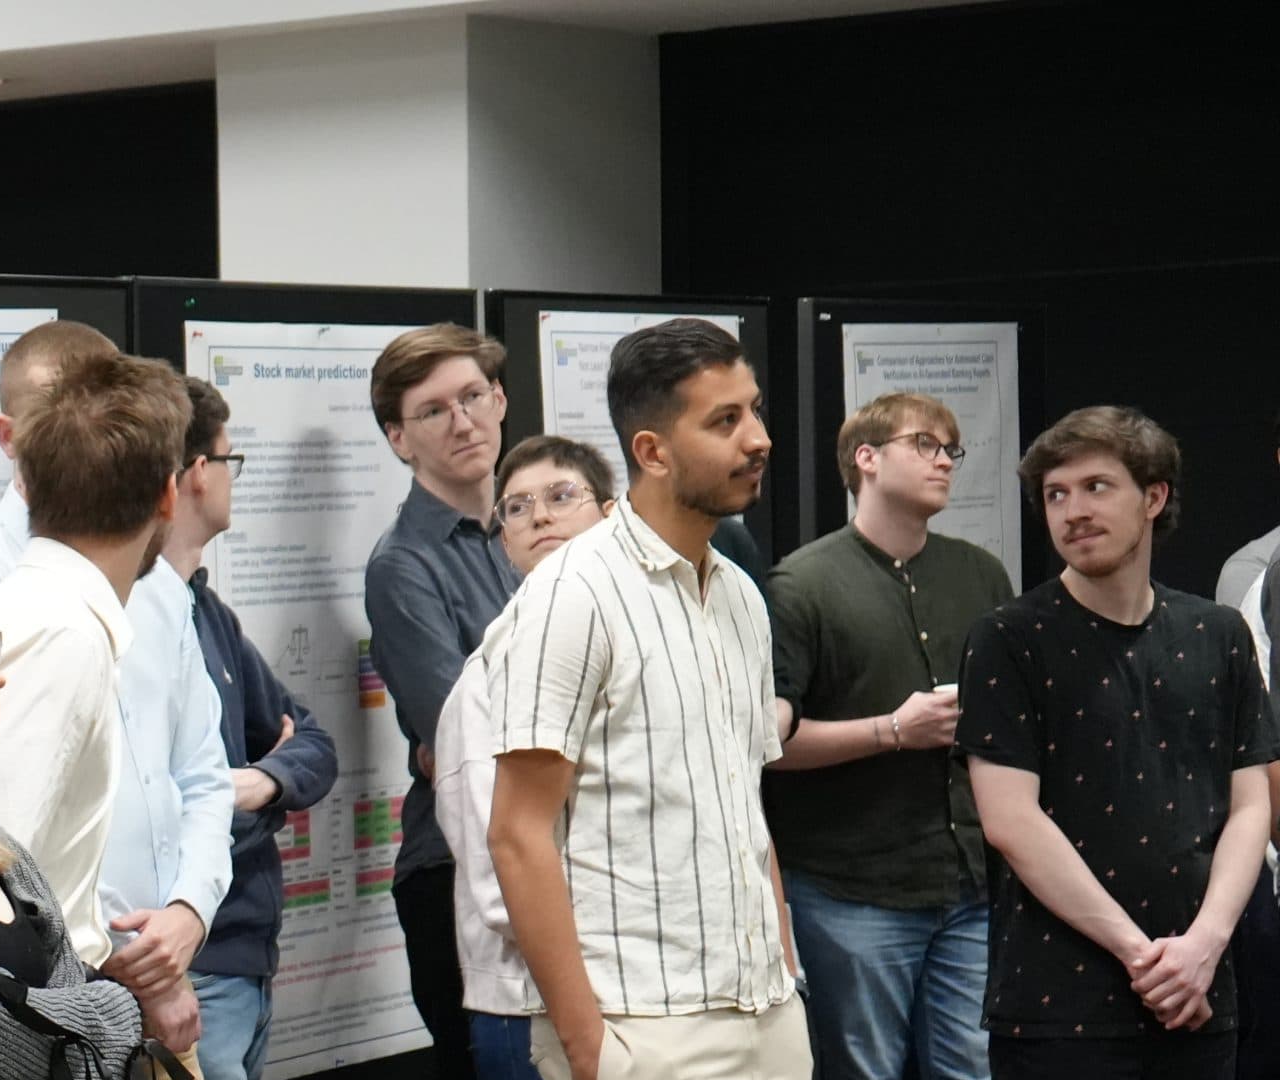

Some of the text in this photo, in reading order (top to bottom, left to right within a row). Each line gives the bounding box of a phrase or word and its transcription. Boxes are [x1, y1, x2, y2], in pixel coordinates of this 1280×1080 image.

[253, 361, 368, 384] Stock market prediction
